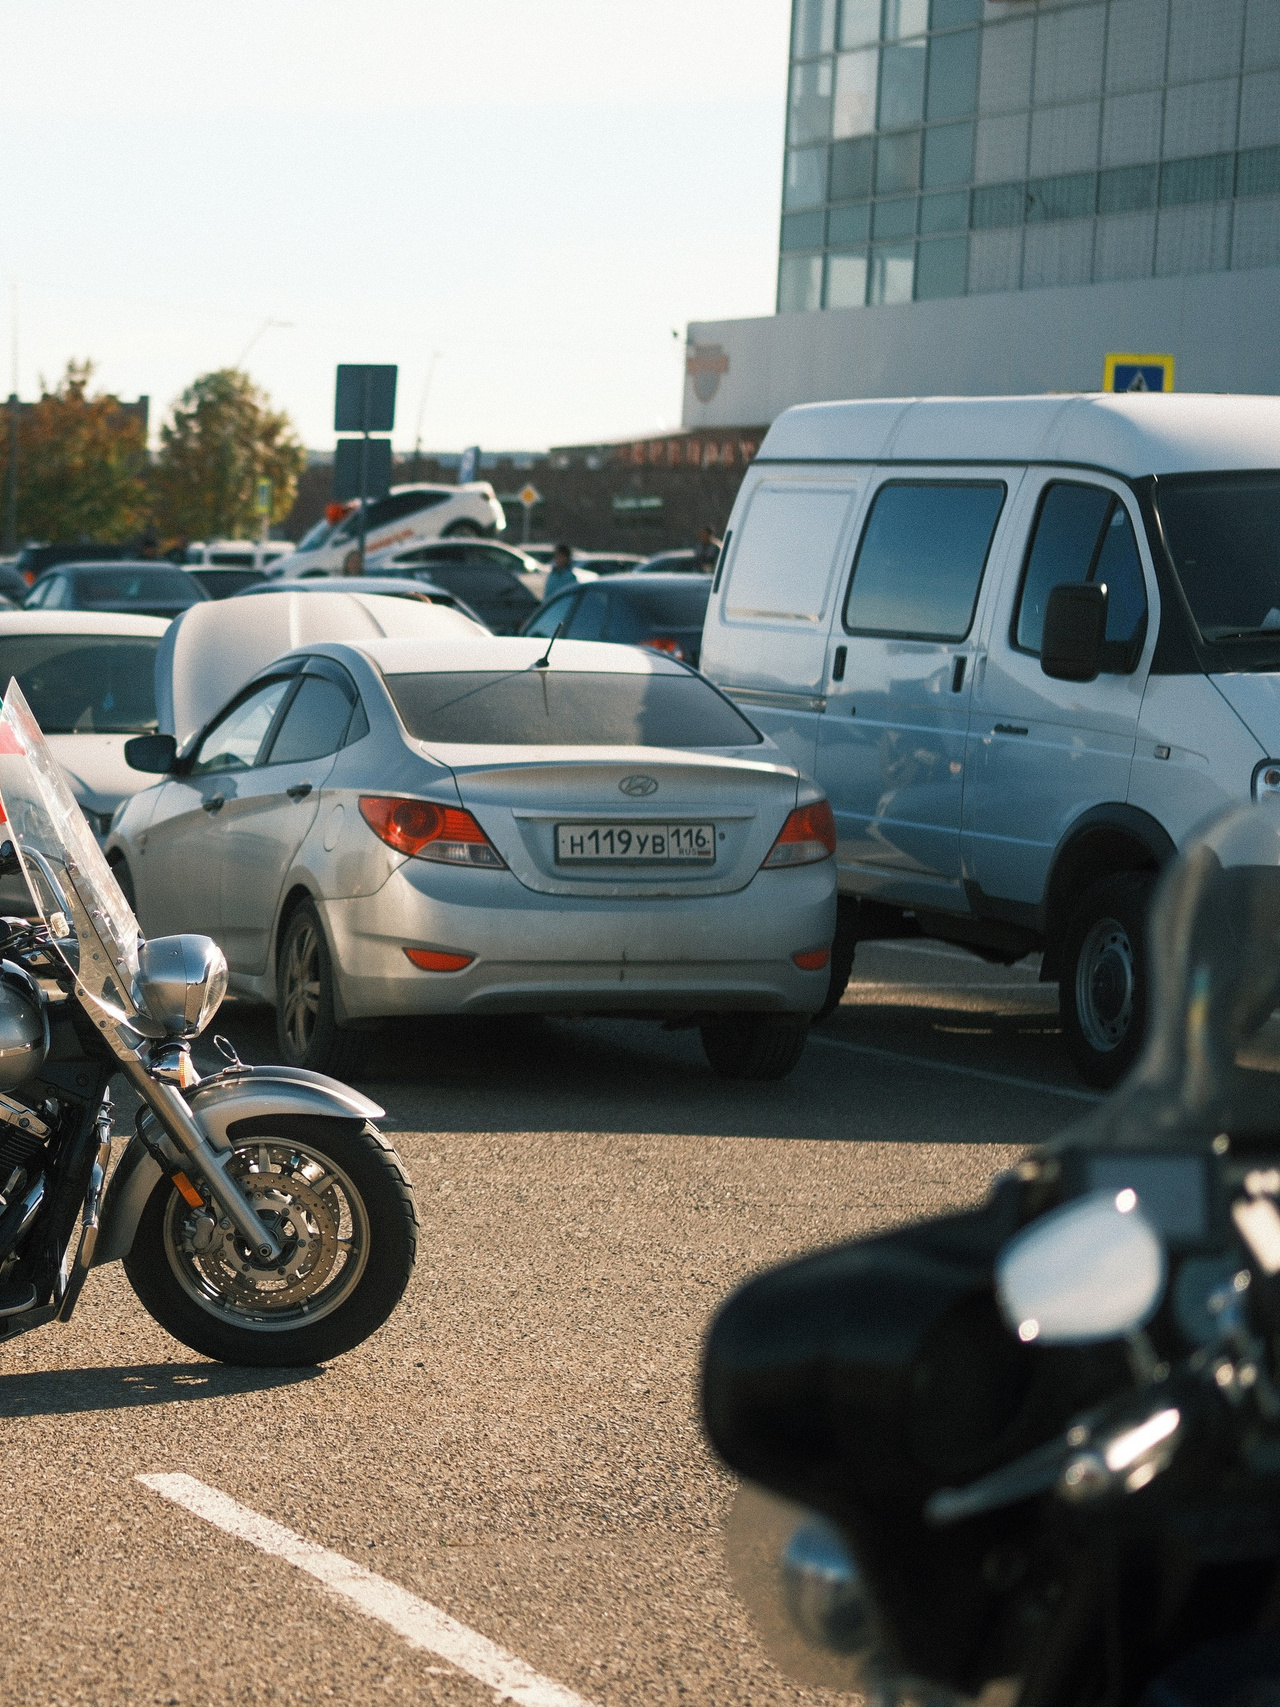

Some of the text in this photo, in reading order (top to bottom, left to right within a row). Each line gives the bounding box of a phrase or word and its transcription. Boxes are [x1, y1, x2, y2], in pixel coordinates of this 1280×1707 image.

[569, 828, 707, 855] Н119УВ 116
[678, 848, 698, 856] RUS
